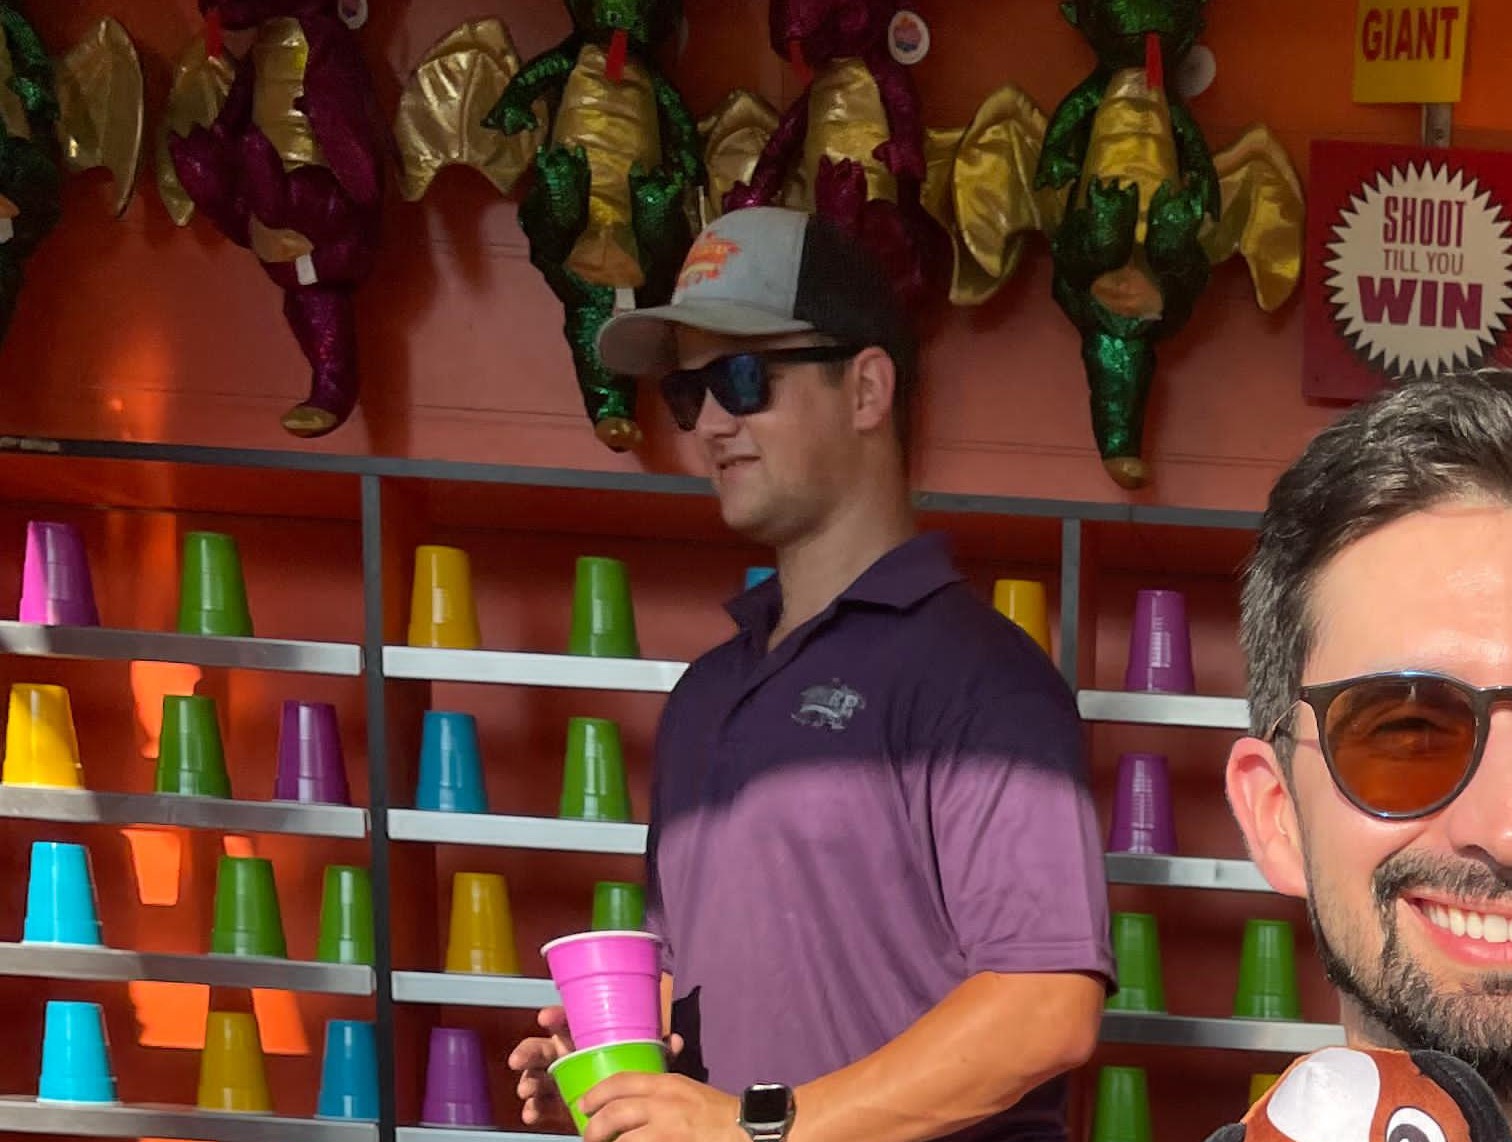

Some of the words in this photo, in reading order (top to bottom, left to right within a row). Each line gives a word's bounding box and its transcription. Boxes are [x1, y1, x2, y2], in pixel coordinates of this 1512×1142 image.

[1362, 6, 1459, 62] GIANT
[1383, 195, 1467, 248] SHOOT
[1384, 249, 1420, 274] TILL
[1425, 251, 1464, 276] YOU
[1357, 276, 1483, 331] WIN
